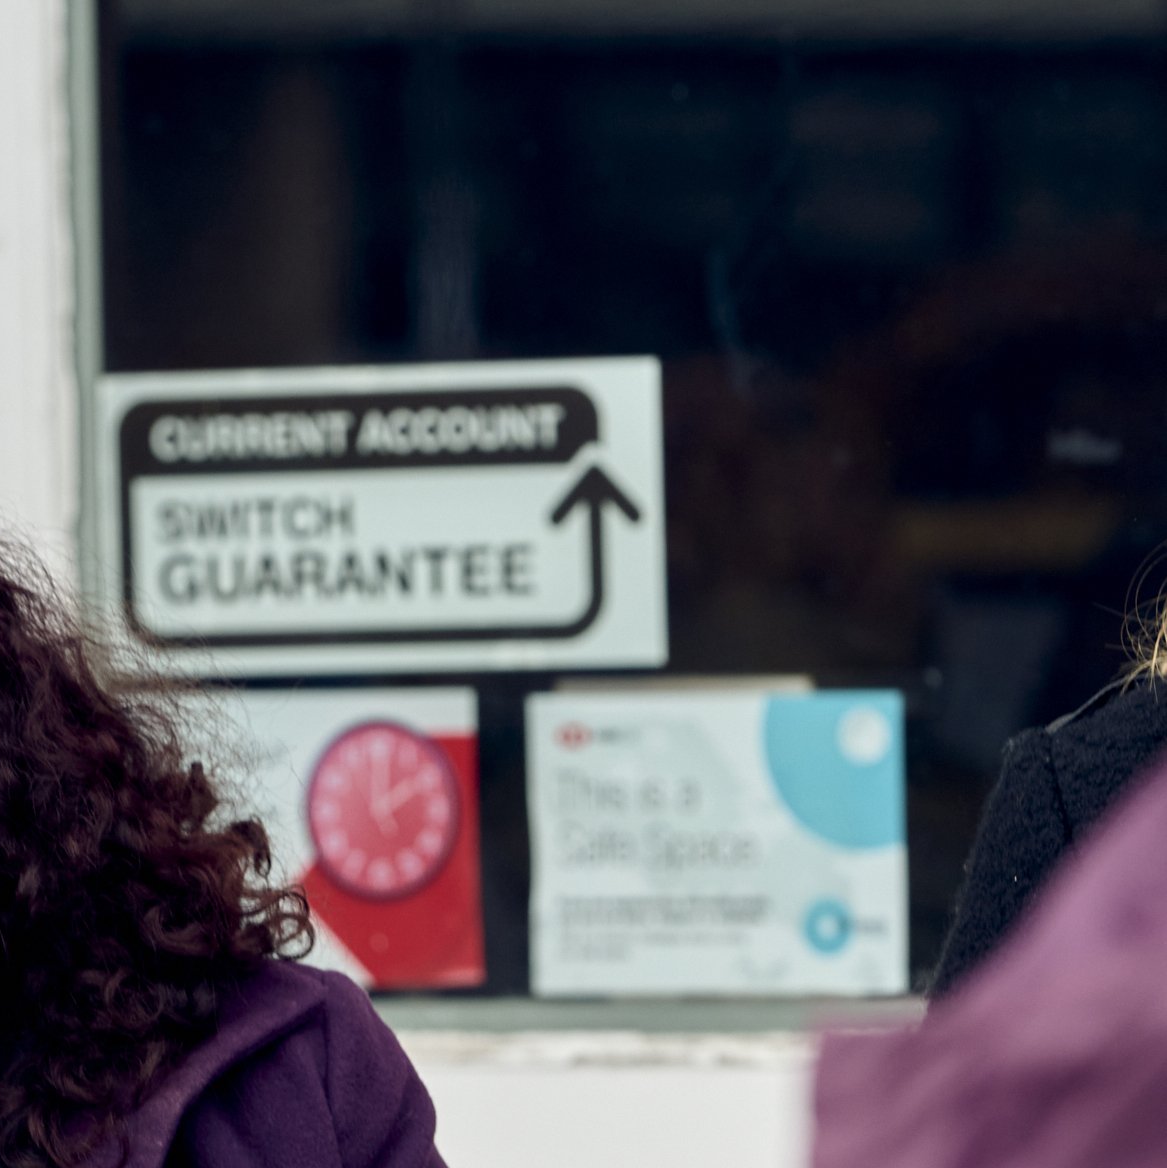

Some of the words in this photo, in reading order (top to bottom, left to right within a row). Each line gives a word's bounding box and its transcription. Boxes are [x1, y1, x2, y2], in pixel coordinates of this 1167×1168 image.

[149, 412, 354, 462] CURRENT
[357, 404, 566, 455] ACCOUNT
[157, 495, 355, 542] SWITCH
[158, 543, 536, 604] GUARANTEE
